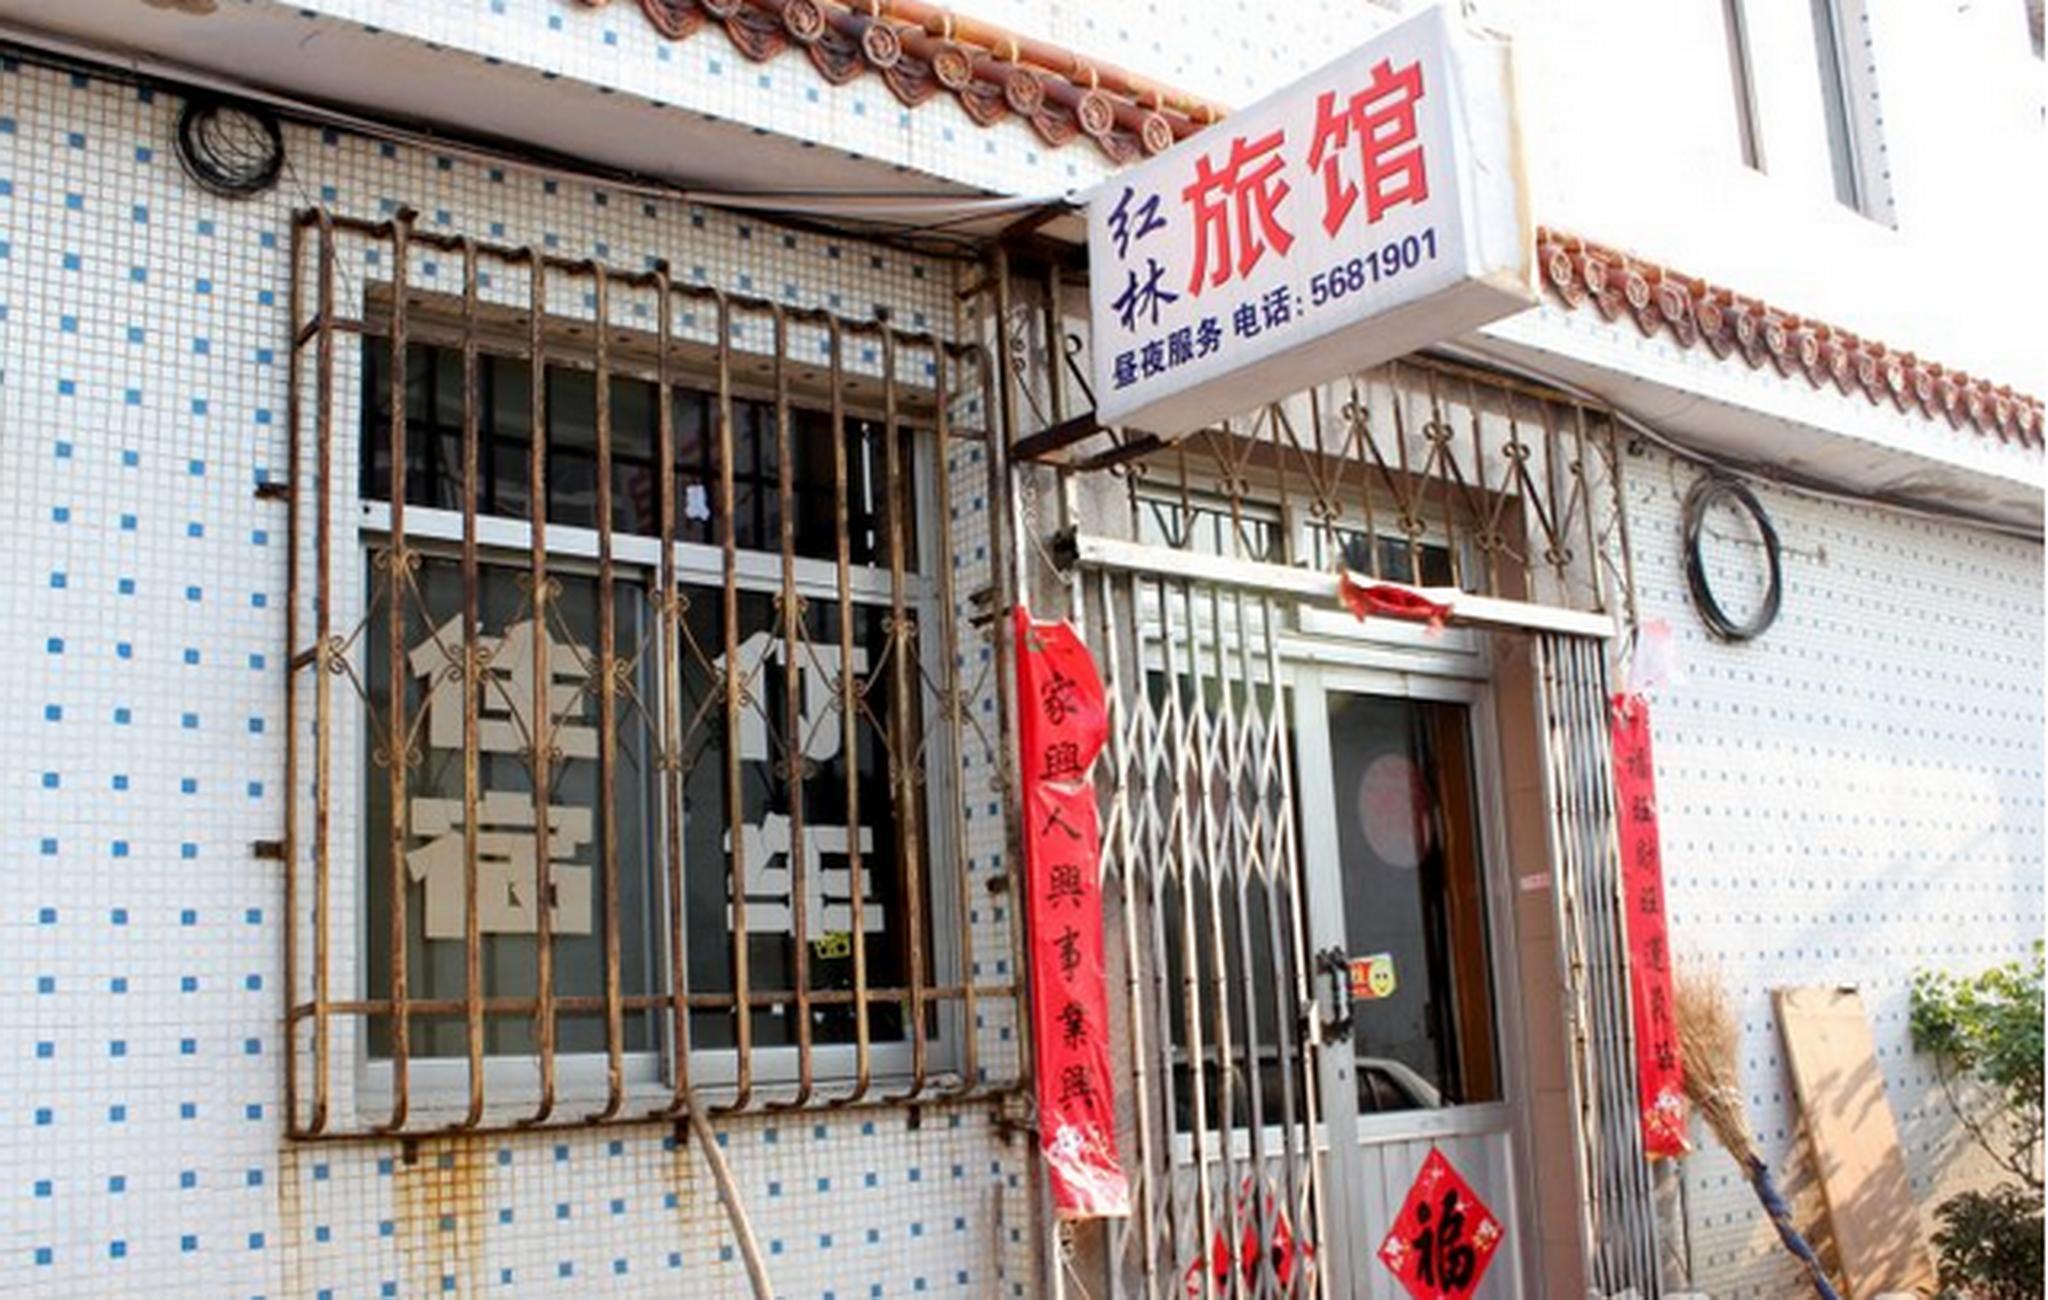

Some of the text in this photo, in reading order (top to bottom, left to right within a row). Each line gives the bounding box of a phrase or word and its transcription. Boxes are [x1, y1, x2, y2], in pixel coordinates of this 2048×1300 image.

[1181, 57, 1430, 299] 旅馆
[1107, 185, 1179, 334] 红林
[1111, 316, 1224, 391] 昼夜服务
[406, 611, 598, 941] 住宿
[1411, 1188, 1477, 1293] 福
